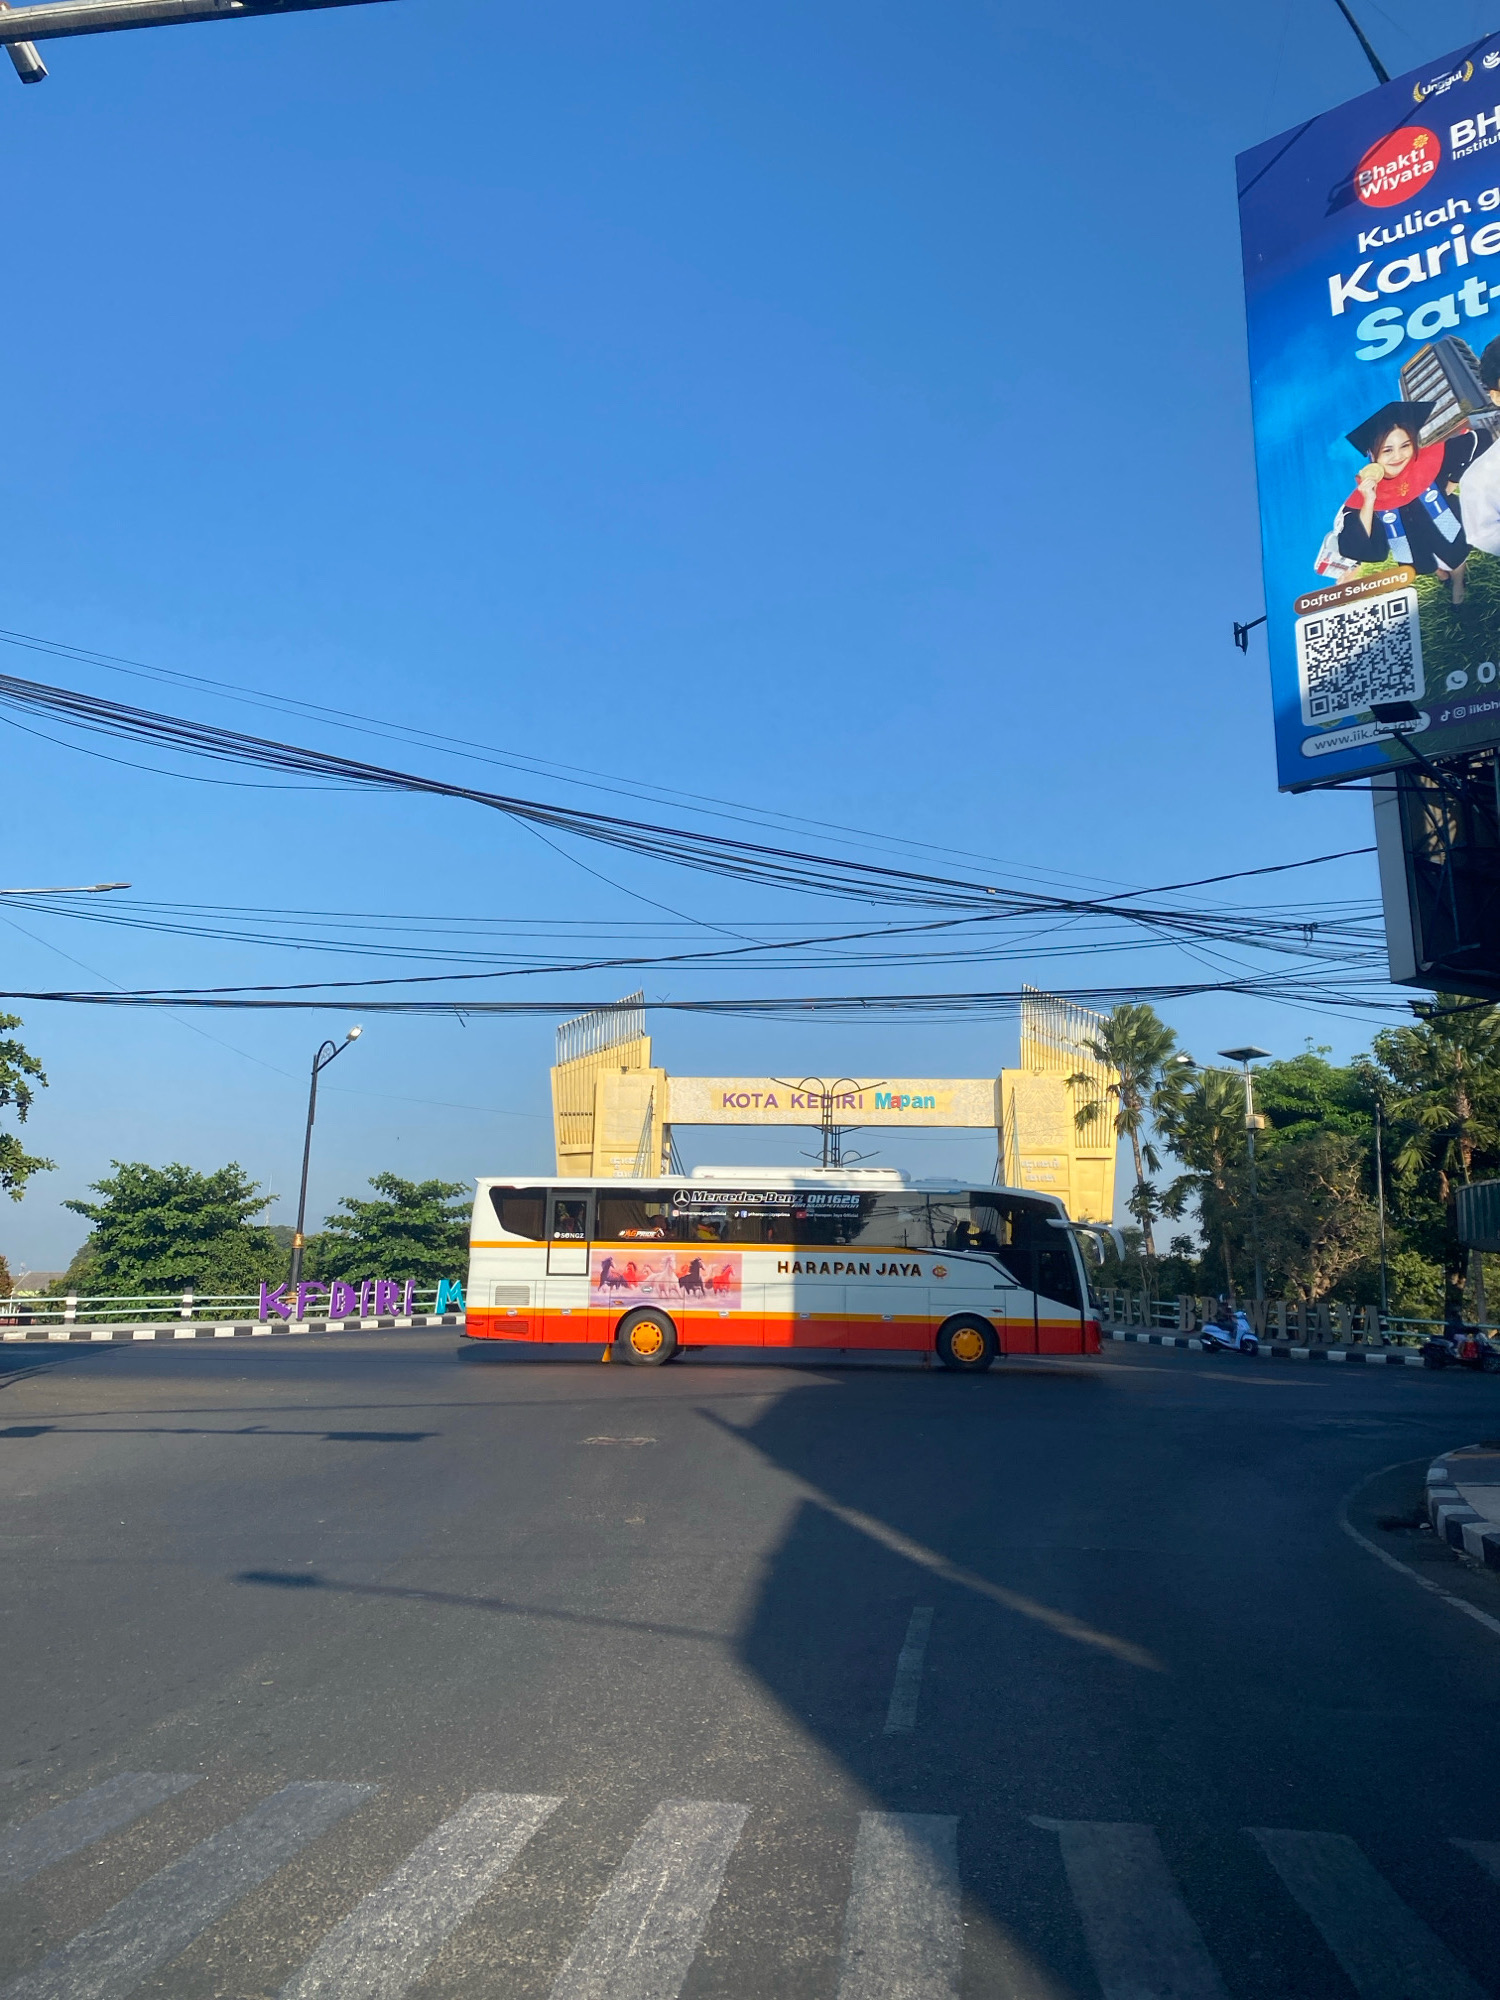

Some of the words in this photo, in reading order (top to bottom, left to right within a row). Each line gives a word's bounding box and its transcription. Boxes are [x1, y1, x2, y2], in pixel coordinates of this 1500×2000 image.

[1422, 70, 1463, 95] Unggul
[1358, 148, 1426, 188] Bhakti
[1360, 160, 1435, 200] Wiyata
[1358, 198, 1471, 253] Kuliah
[1328, 222, 1500, 317] Karie
[1301, 591, 1342, 610] Daftar
[1344, 571, 1409, 597] Sekarang
[1477, 661, 1500, 684] 0
[1469, 700, 1500, 715] iikbh
[722, 1092, 779, 1109] KOTA
[791, 1093, 863, 1109] KEDIRI
[875, 1092, 935, 1111] Mapan
[691, 1190, 804, 1205] Mercedes-Benz
[827, 1194, 860, 1204] 1626
[777, 1261, 871, 1276] HARAPAN
[876, 1263, 922, 1277] JAYA
[1175, 1294, 1385, 1346] BRWIJAYA
